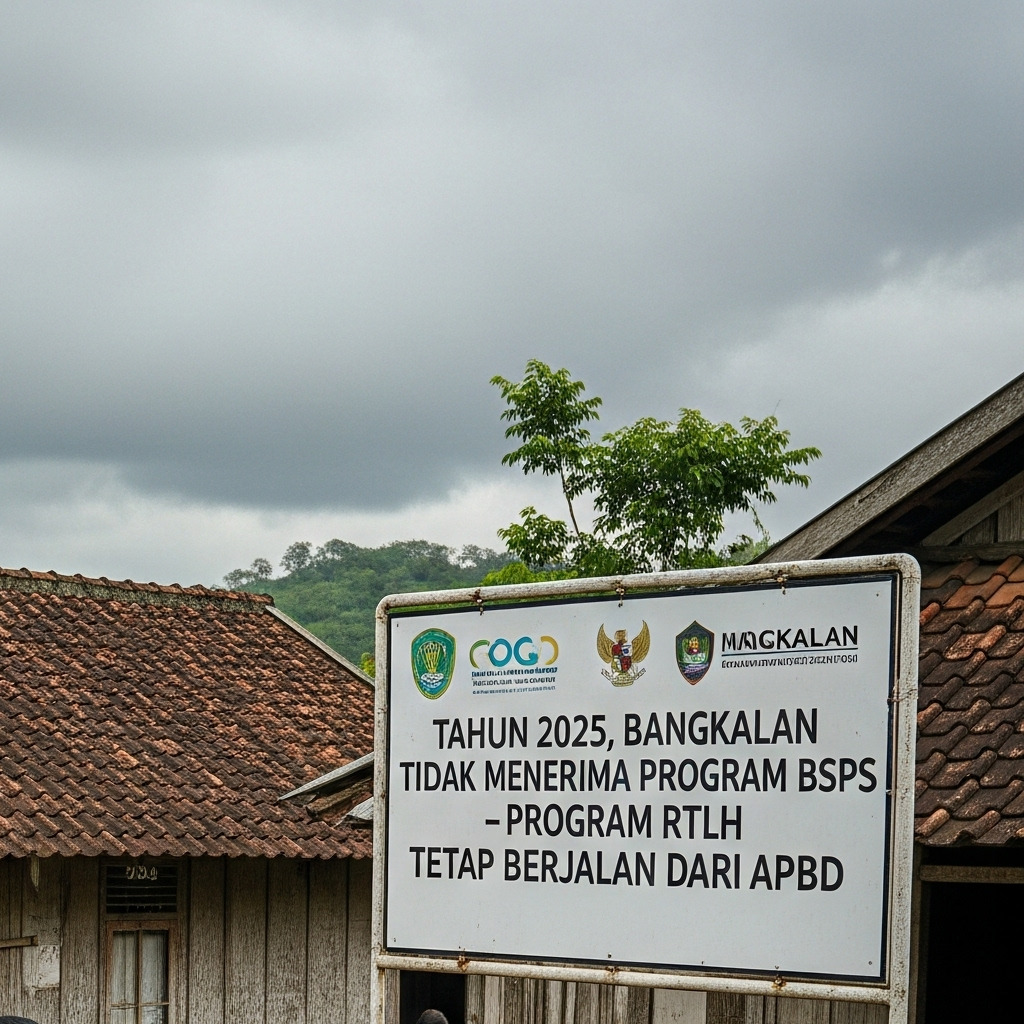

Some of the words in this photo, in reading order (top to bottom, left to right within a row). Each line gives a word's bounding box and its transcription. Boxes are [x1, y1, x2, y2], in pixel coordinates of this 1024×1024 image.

[432, 716, 528, 750] TAHUN
[536, 714, 615, 752] 2025,
[624, 707, 818, 747] BANGKALAN
[399, 760, 477, 792] TIDAK
[484, 758, 632, 792] MENERIMA
[640, 757, 787, 793] PROGRAM
[798, 757, 878, 793] BSPS
[662, 804, 742, 841] RTLH
[409, 846, 495, 880] TETAP
[504, 848, 656, 887] BERJALAN
[667, 852, 741, 890] DARI
[749, 854, 844, 892] APBD
